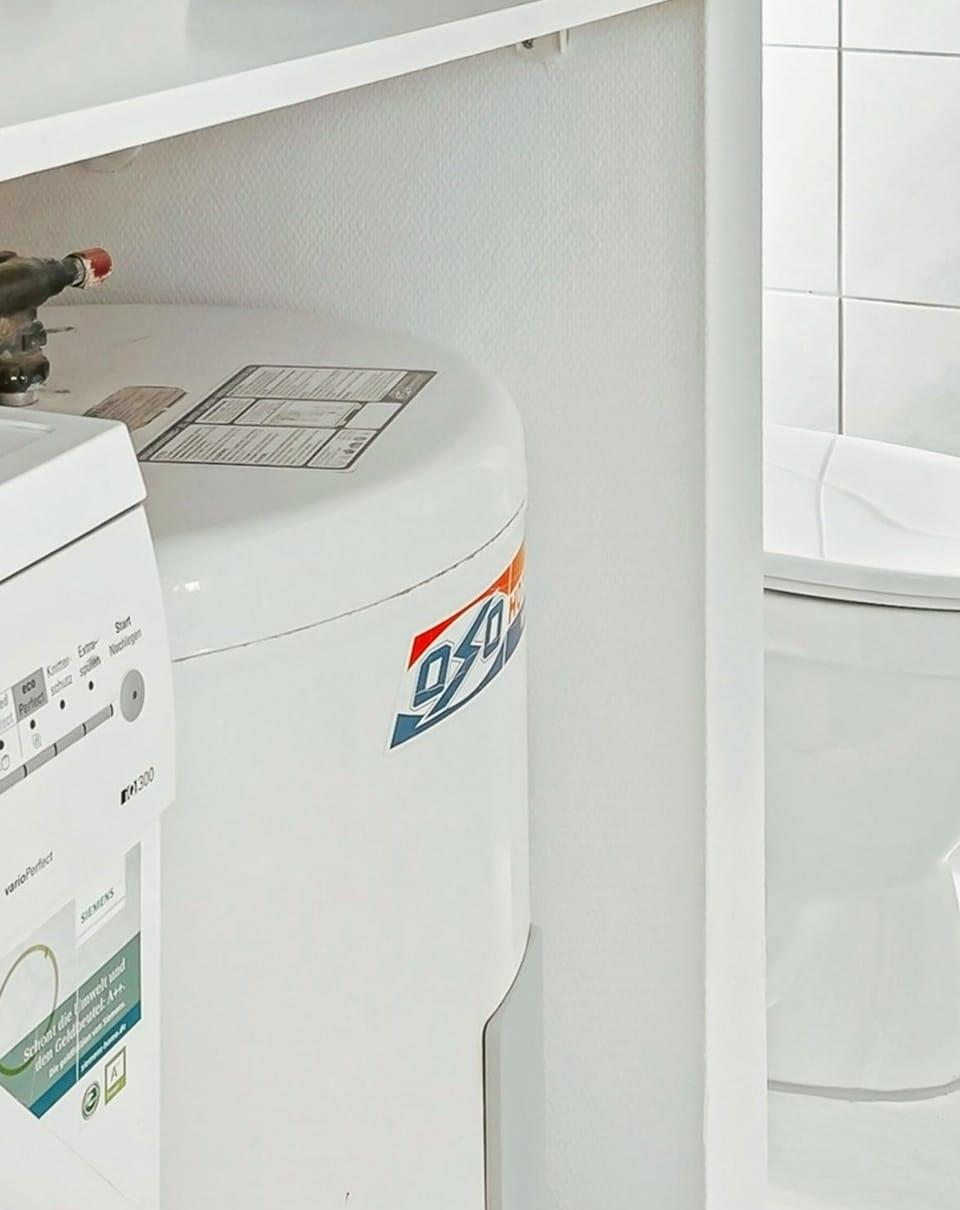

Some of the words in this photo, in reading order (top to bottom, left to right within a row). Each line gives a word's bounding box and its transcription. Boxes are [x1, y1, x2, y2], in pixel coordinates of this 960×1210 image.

[21, 678, 37, 695] eco
[18, 692, 46, 717] Perfect
[4, 851, 53, 896] varioPerfect
[80, 887, 115, 924] SIEMENS
[23, 1026, 57, 1063] Schont
[57, 1010, 73, 1032] die
[108, 957, 127, 983] und
[34, 1047, 54, 1073] den
